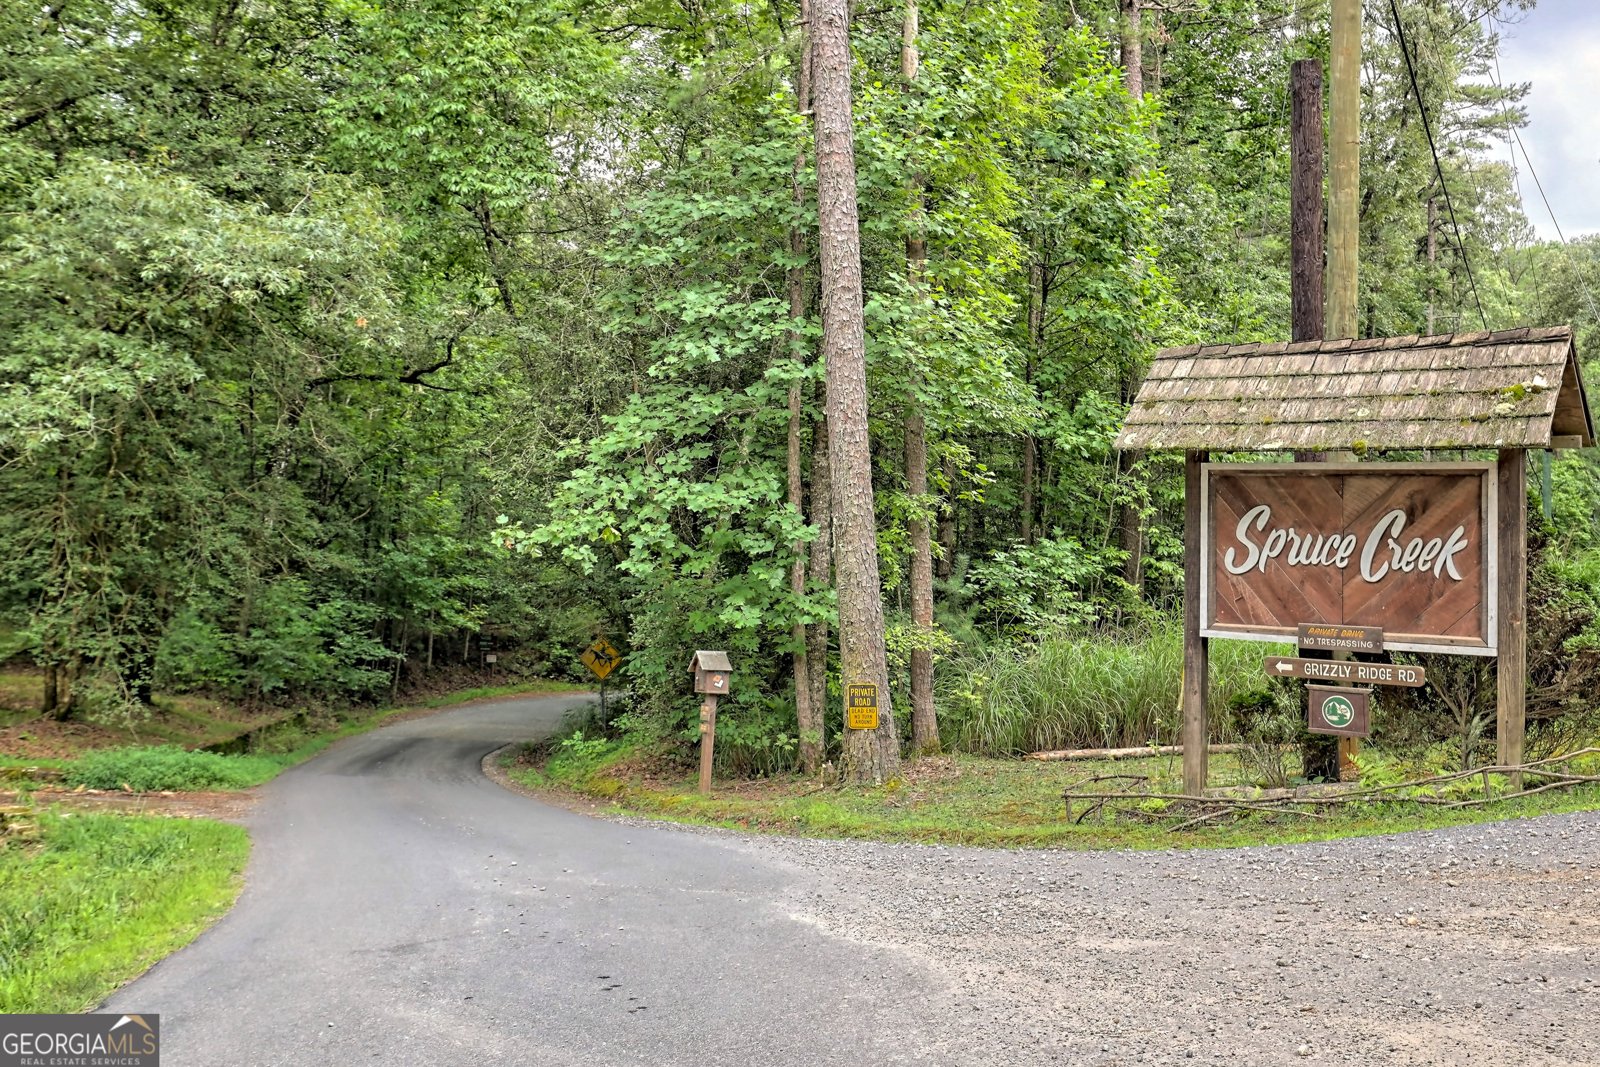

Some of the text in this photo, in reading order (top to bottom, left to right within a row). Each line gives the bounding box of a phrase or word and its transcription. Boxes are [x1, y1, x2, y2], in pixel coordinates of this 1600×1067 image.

[1224, 504, 1468, 583] Spruce Creek
[1307, 627, 1366, 638] PRIVATE DRIVE
[1303, 637, 1374, 649] NO TRESPASSING
[1304, 662, 1418, 683] GRIZZLY RIDGE RD.
[850, 688, 874, 696] PRIVATE
[854, 697, 871, 705] ROAD
